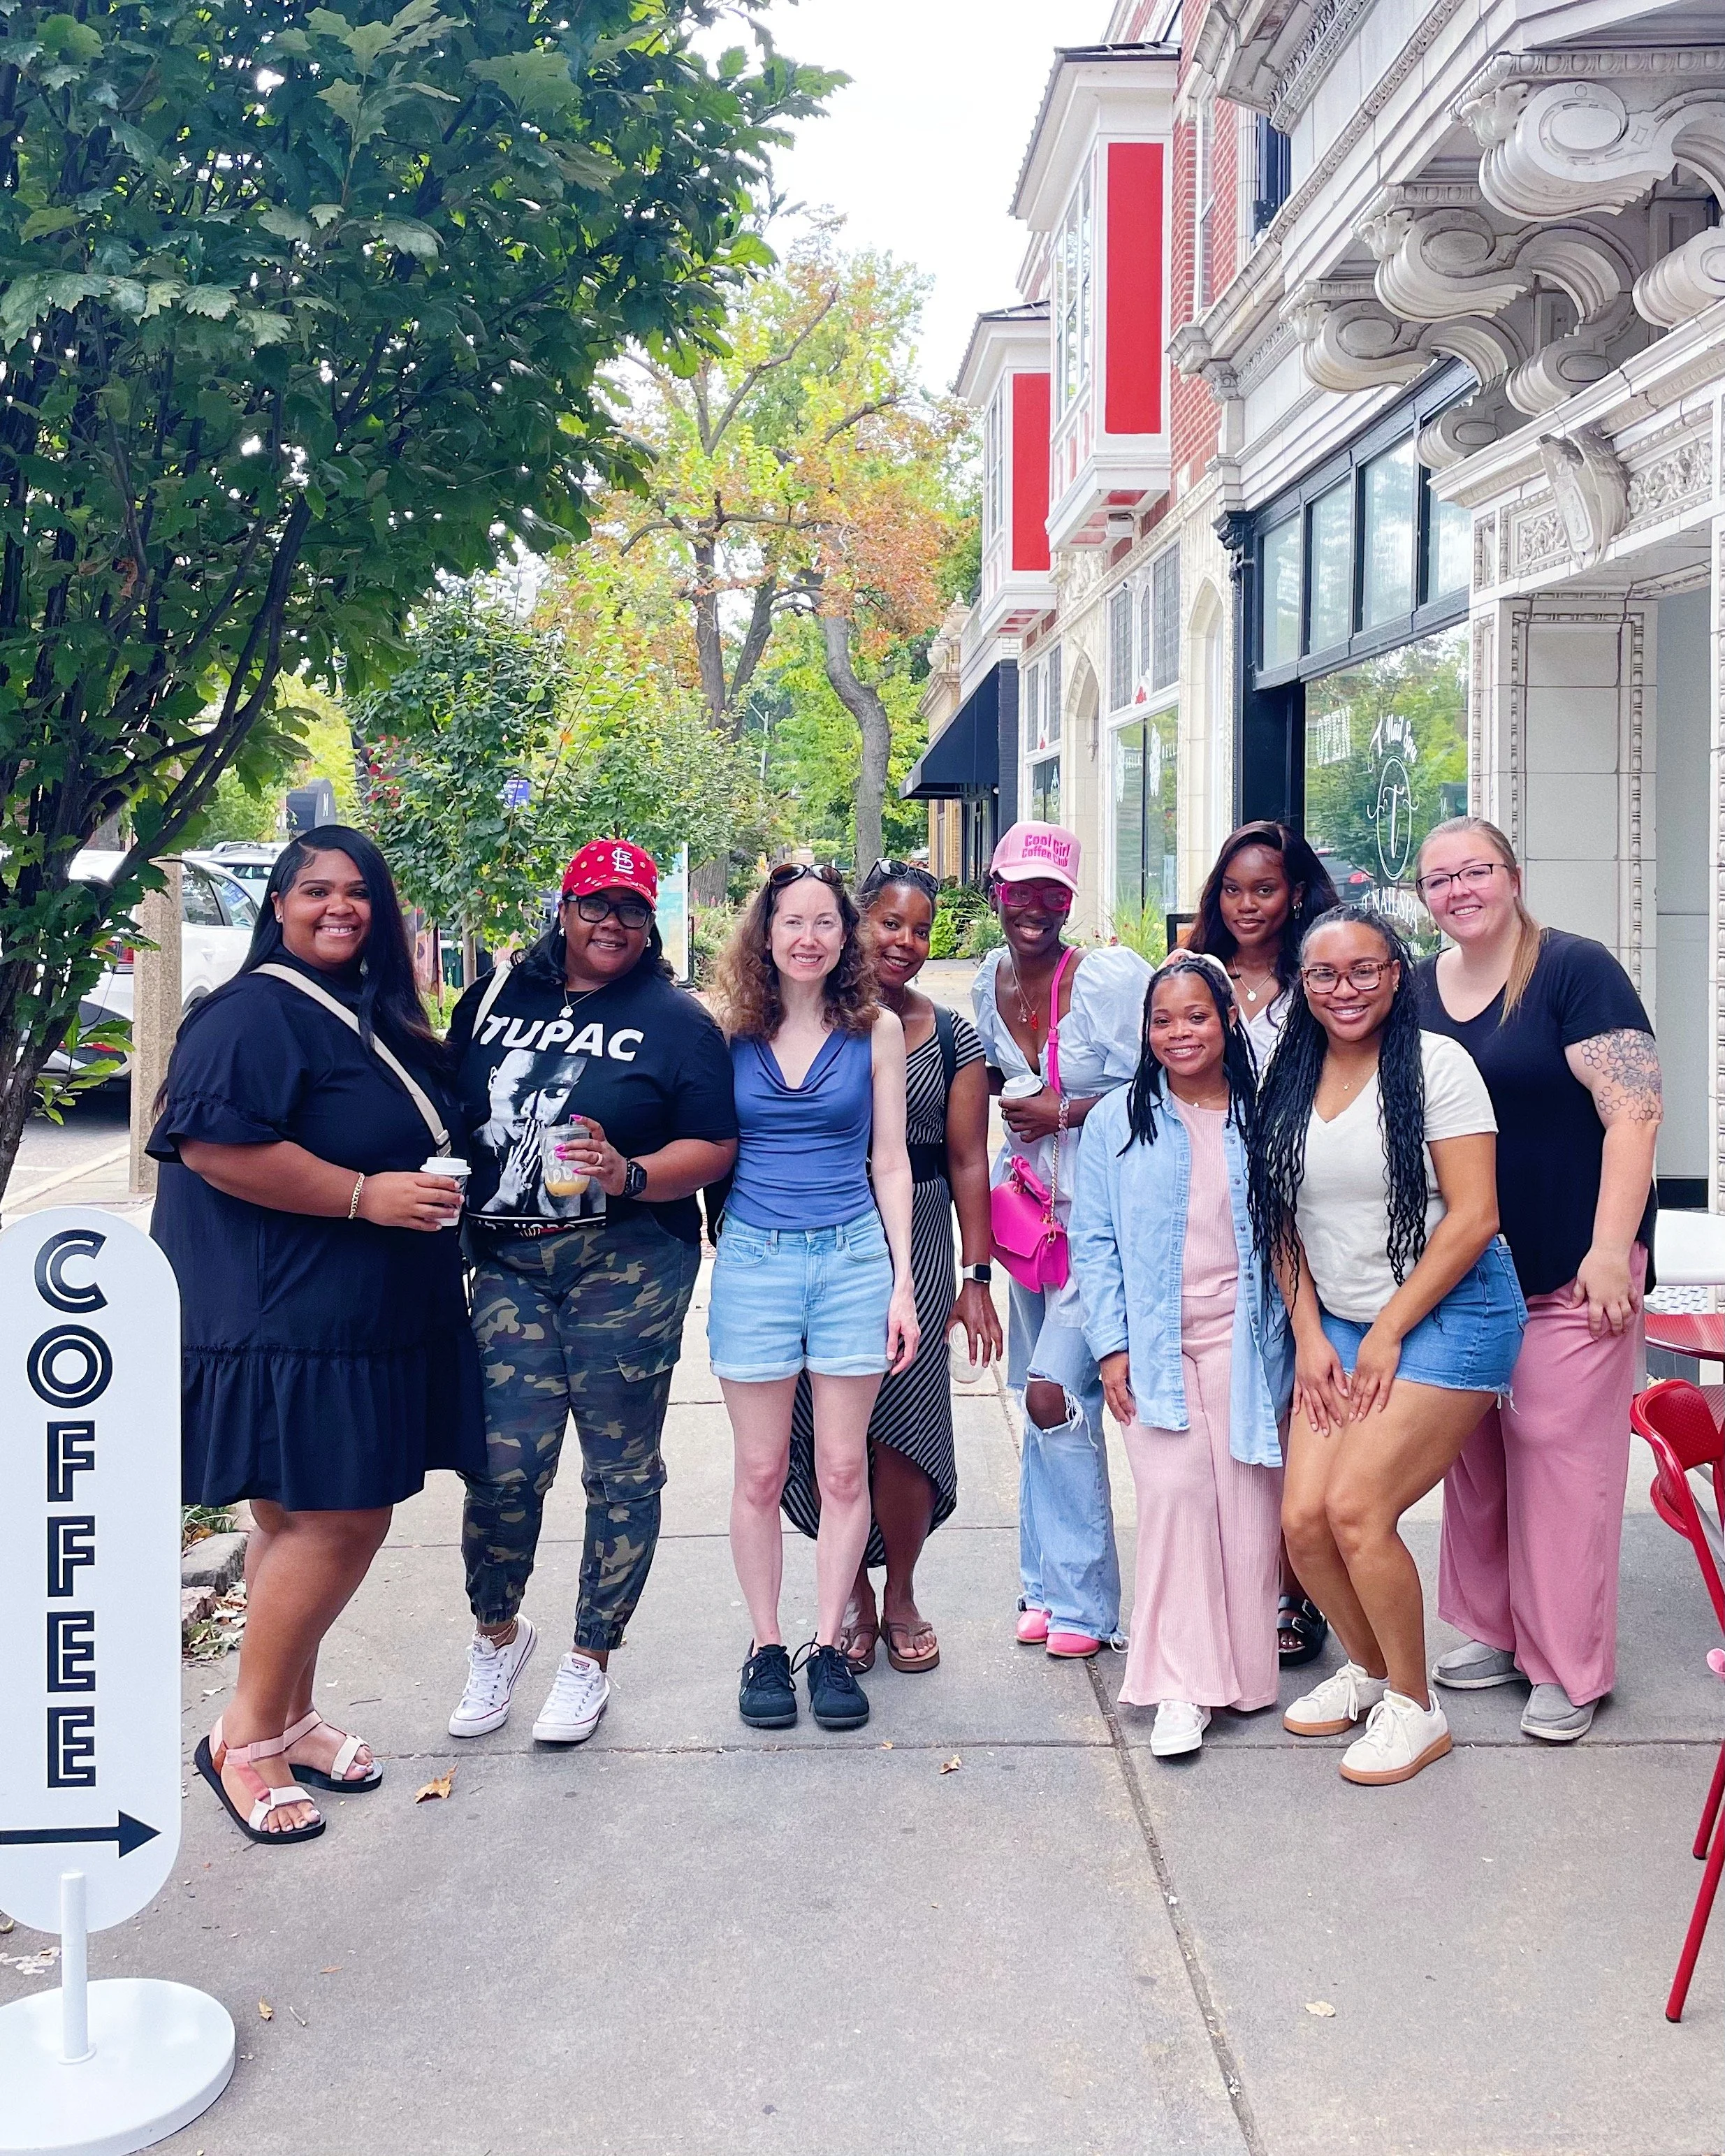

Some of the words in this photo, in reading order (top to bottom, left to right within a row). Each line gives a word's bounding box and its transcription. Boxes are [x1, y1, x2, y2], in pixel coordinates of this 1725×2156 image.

[1385, 713, 1404, 743] Nail
[1403, 720, 1418, 764] Spa
[323, 793, 329, 817] M
[1022, 845, 1051, 860] Coffee
[1053, 854, 1068, 867] Club
[1025, 833, 1051, 847] Cool
[1054, 839, 1070, 857] Girl
[480, 1014, 644, 1061] TUPAC
[27, 1228, 113, 1789] COFFEE
